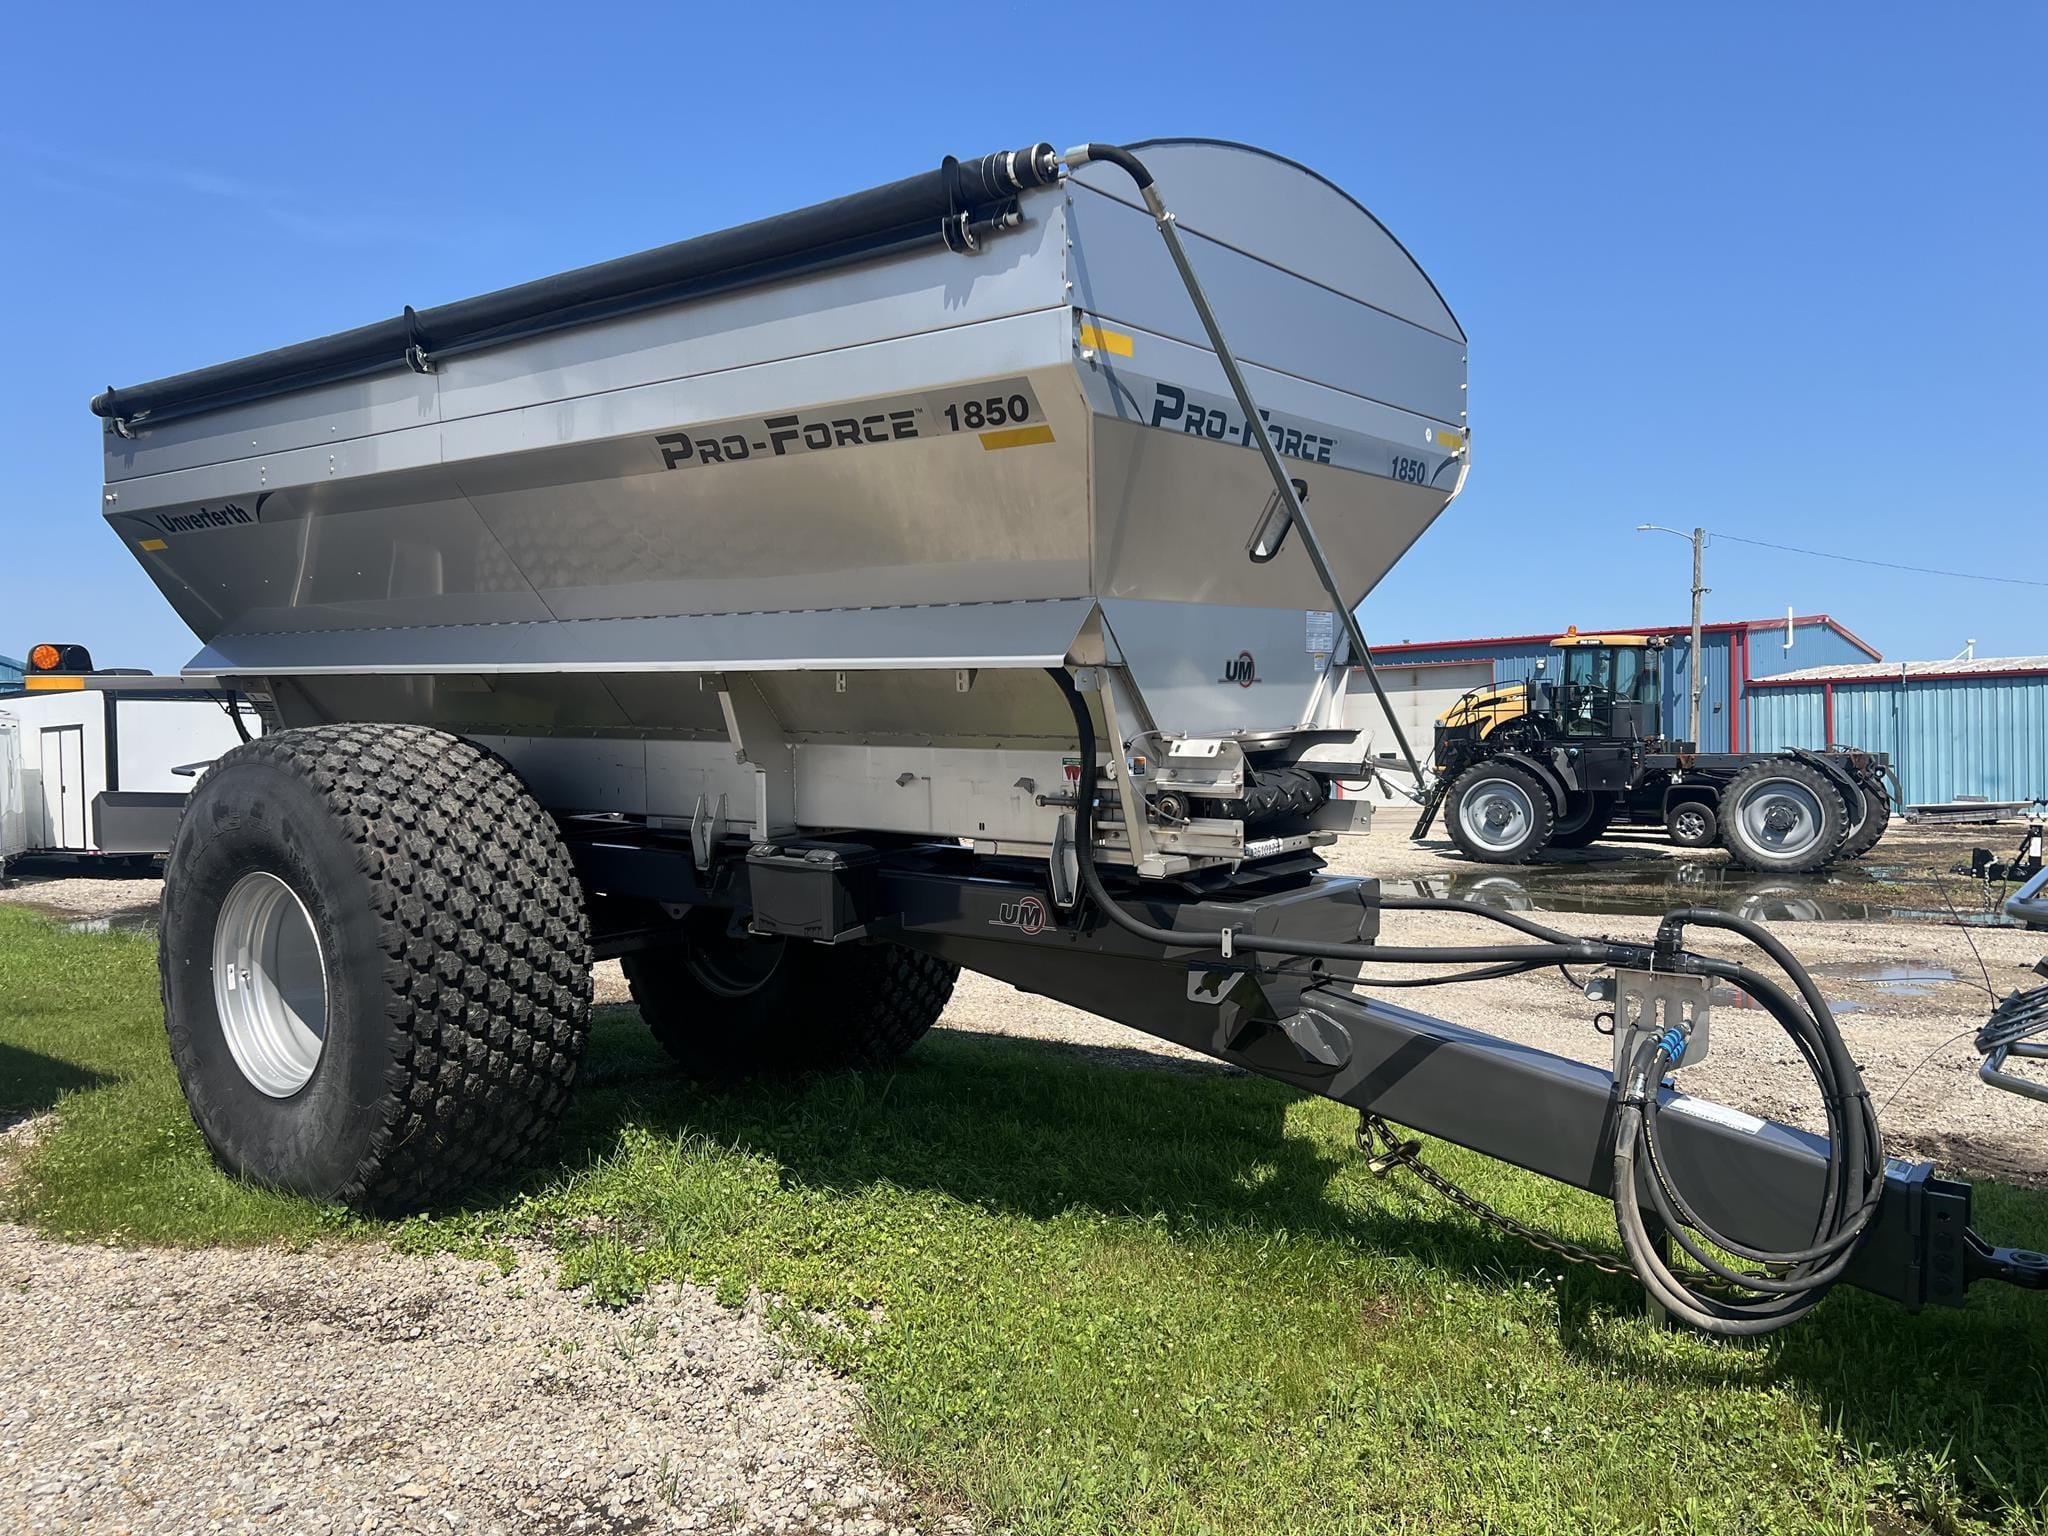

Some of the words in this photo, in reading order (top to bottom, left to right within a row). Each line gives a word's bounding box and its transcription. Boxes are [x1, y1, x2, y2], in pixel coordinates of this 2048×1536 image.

[944, 394, 1029, 432] 1850
[1391, 456, 1426, 485] 1850
[156, 503, 253, 533] Unverferth
[1224, 657, 1253, 684] UM
[999, 901, 1043, 929] UM
